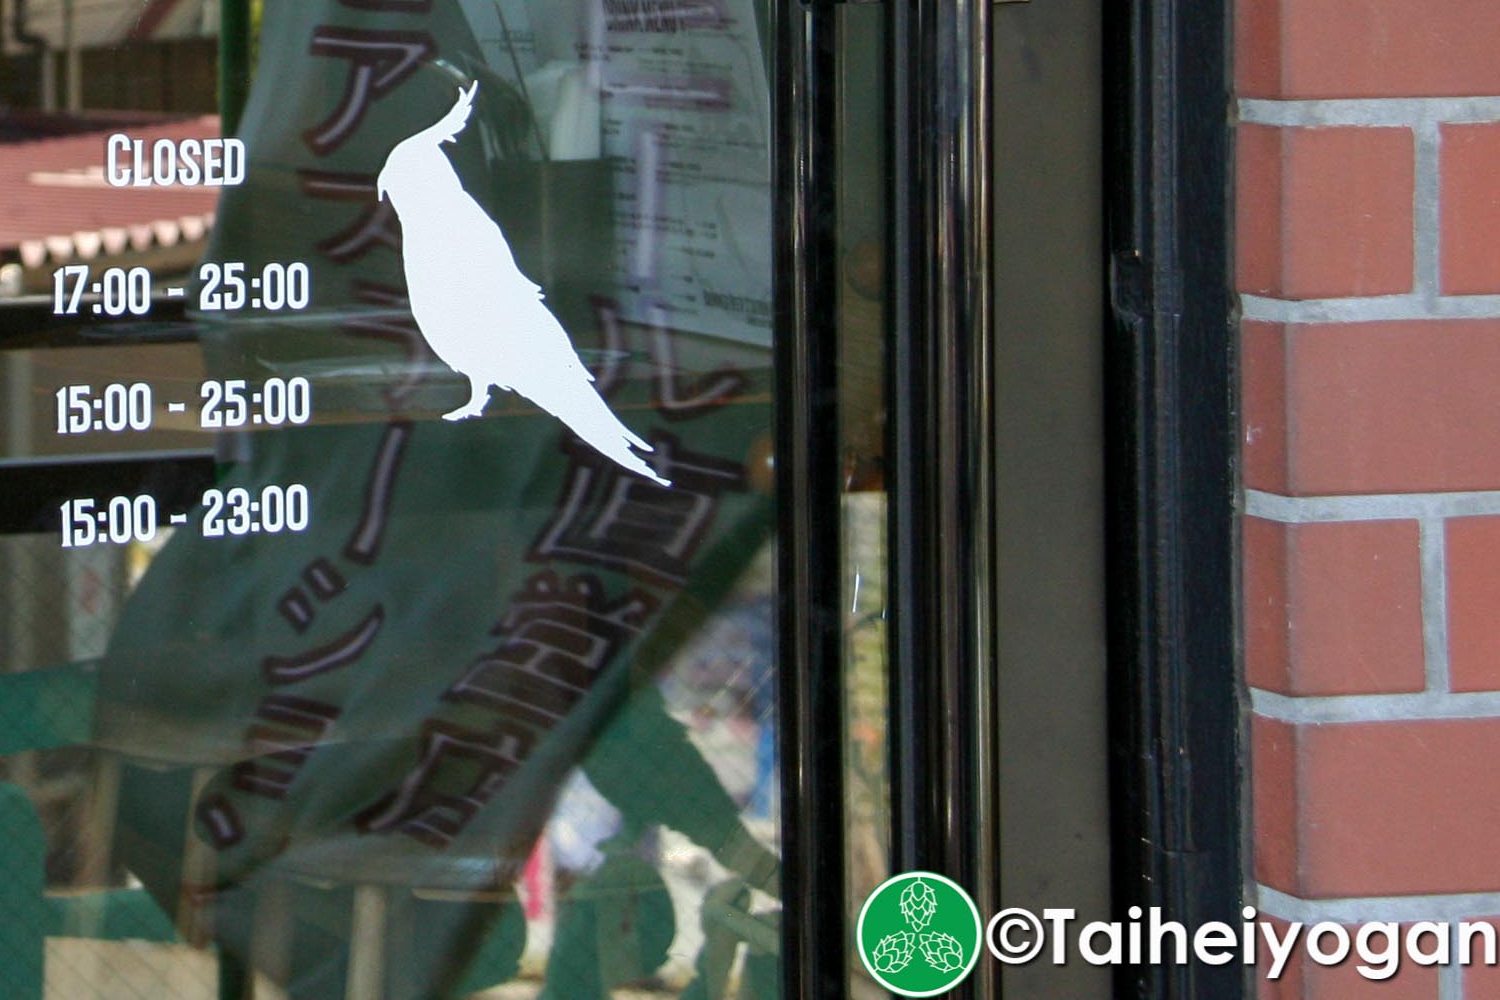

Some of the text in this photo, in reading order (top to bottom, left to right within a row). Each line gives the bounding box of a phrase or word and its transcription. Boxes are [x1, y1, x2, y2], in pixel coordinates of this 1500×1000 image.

[107, 133, 246, 187] CLOSED
[53, 265, 151, 315] 17:00
[199, 262, 310, 311] 25:00
[56, 383, 152, 434] 15:00
[200, 377, 311, 428] 25:00
[60, 493, 157, 547] 15:00
[202, 484, 309, 537] 23:00
